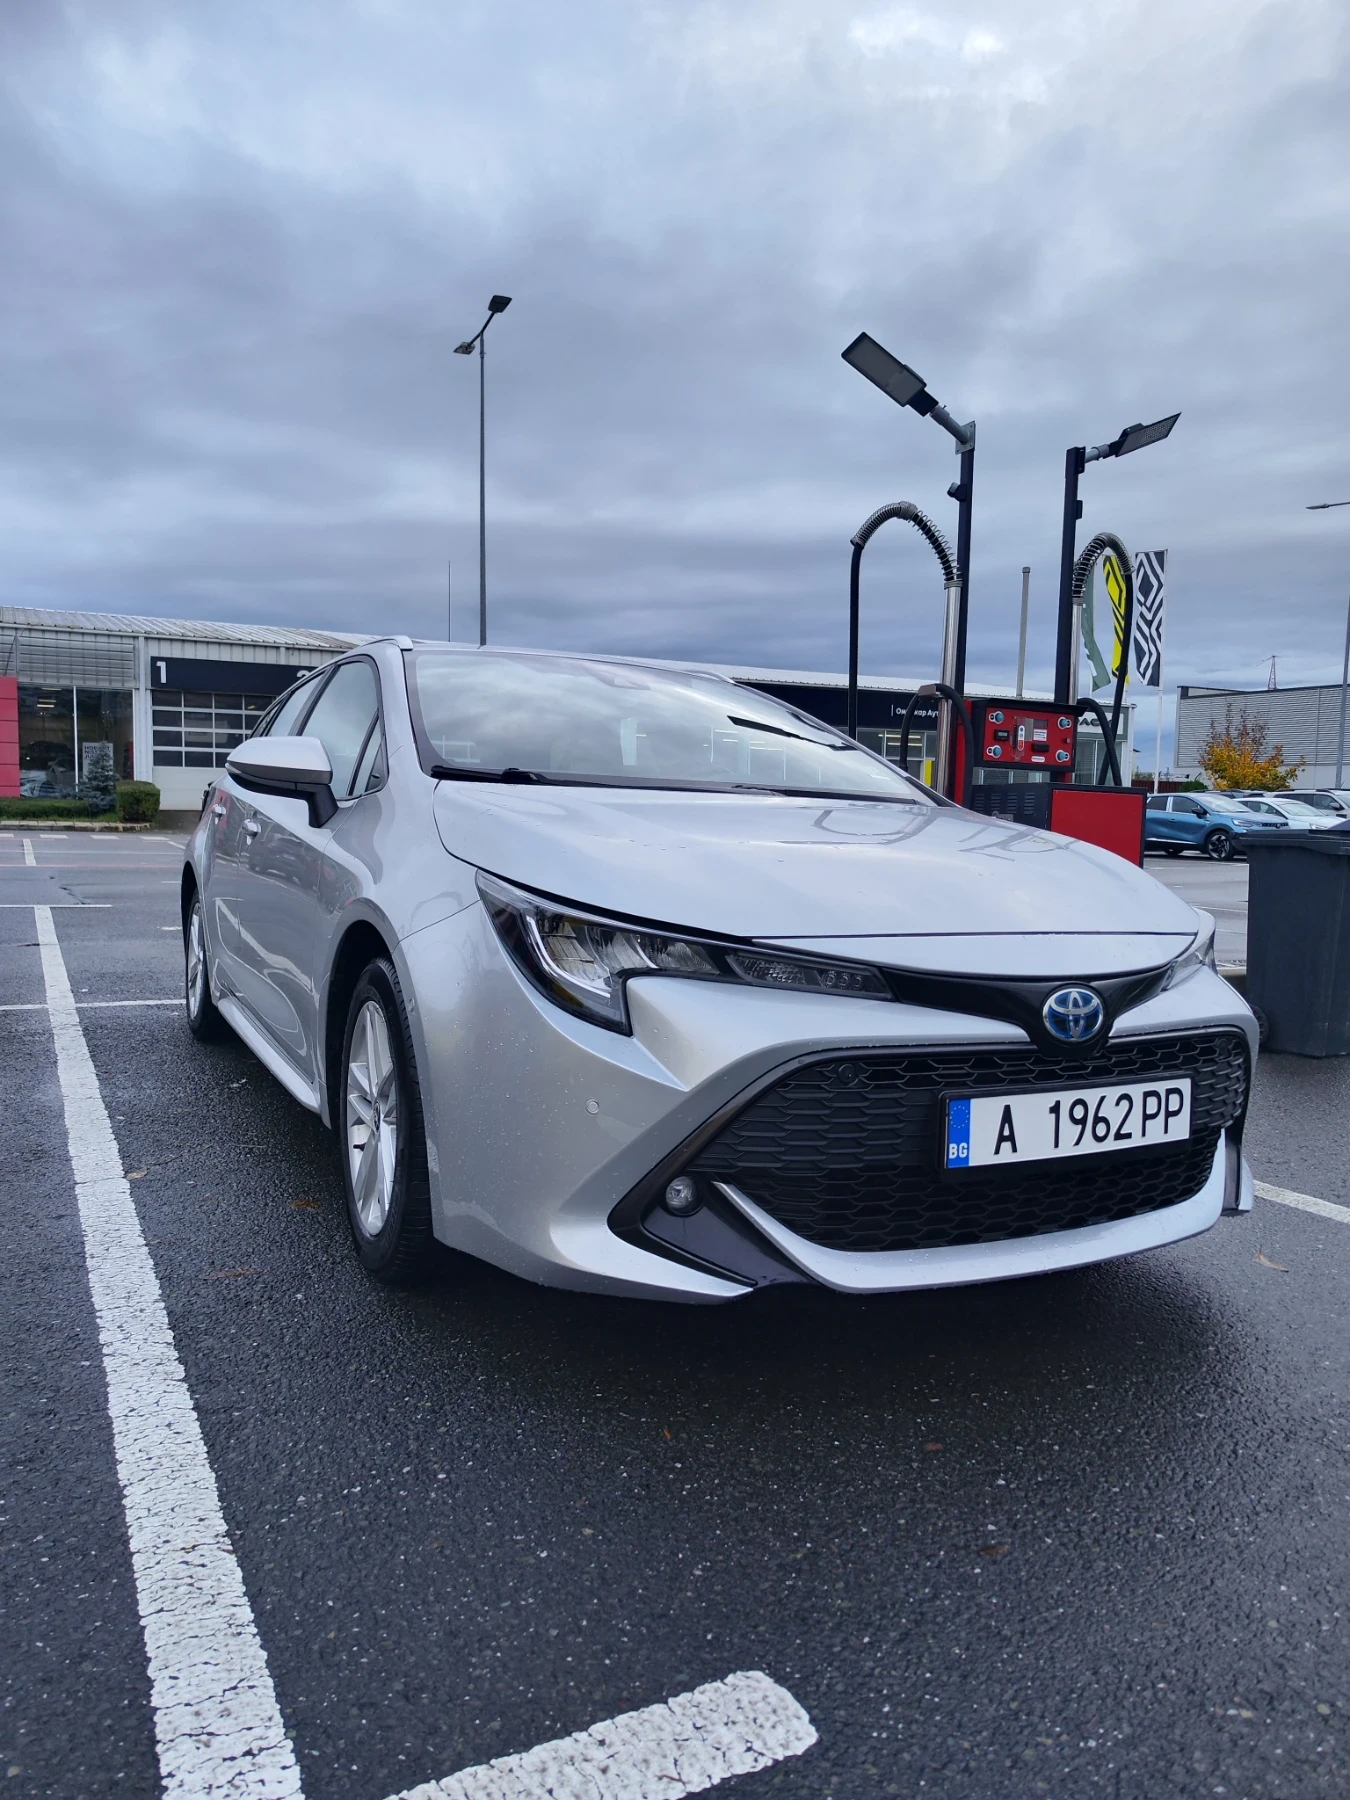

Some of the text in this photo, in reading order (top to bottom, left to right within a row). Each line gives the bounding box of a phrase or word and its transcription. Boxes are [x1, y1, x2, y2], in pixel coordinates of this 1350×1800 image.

[156, 661, 167, 683] 1
[993, 1104, 1018, 1156] A
[948, 1142, 968, 1159] BG
